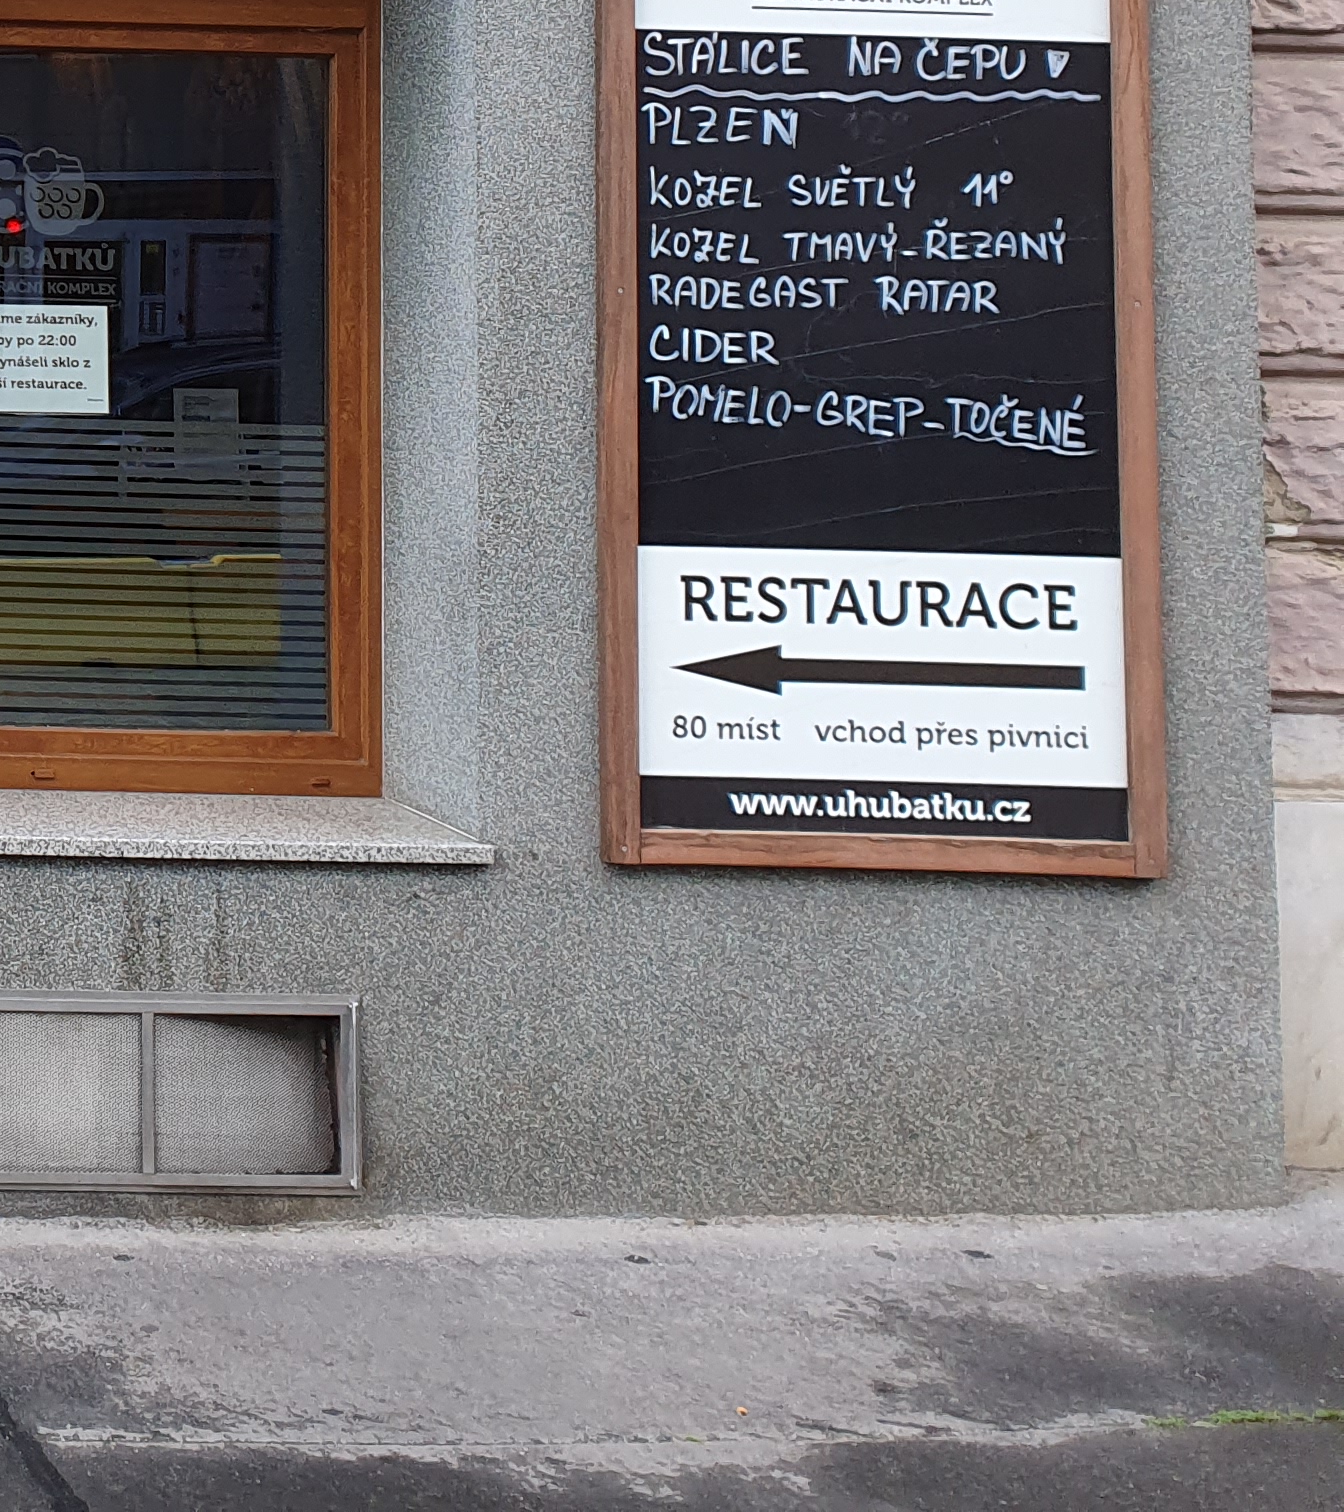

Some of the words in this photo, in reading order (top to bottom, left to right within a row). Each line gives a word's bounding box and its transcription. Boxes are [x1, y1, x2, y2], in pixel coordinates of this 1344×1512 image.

[643, 31, 810, 76] STÁLICE
[846, 36, 902, 78] NA
[916, 38, 1027, 81] ČEPU
[640, 102, 799, 149] PLZEŇ
[649, 166, 762, 209] KOZEL
[788, 164, 916, 209] SVĚTLÝ
[962, 169, 1014, 208] 11°
[649, 224, 760, 265] KOZEL
[47, 281, 117, 296] KOMPLEX
[649, 274, 849, 310] RADEGAST
[874, 276, 1001, 315] RATAR
[25, 313, 99, 328] zákazníky,
[17, 336, 34, 348] po
[38, 335, 77, 346] 22:00
[649, 325, 779, 366] CIDER
[51, 357, 80, 368] sklo
[83, 359, 91, 368] z
[10, 378, 88, 390] restaurace.
[680, 574, 1079, 631] RESTAURACE
[672, 716, 706, 740] 80
[717, 716, 781, 741] míst
[814, 719, 907, 745] vchod
[916, 723, 978, 751] přes
[988, 725, 1089, 753] pivnici
[727, 790, 1033, 823] www.uhubatku.cz
